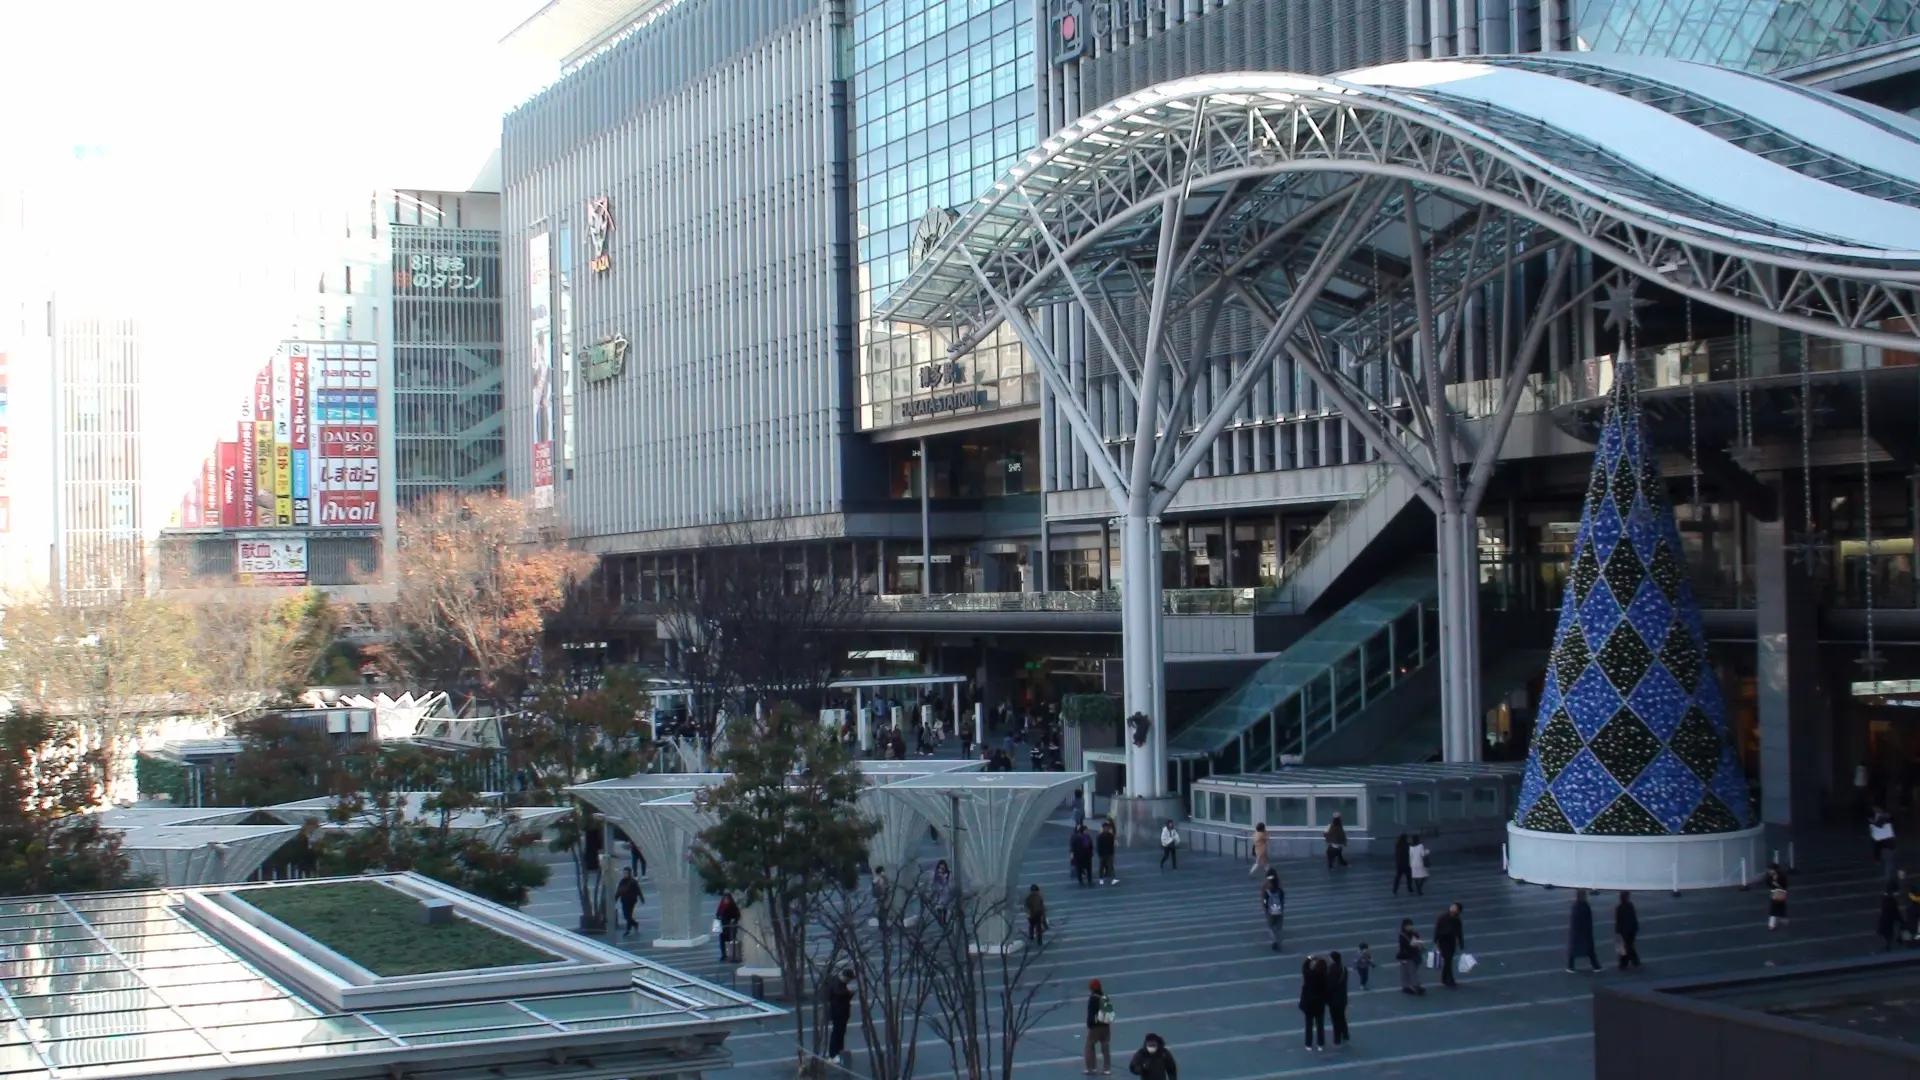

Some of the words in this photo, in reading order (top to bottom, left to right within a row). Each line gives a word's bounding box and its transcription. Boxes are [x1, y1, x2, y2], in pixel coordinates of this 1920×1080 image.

[902, 398, 935, 417] HAKATA
[935, 389, 979, 413] STATION
[324, 431, 374, 442] DAISO
[321, 466, 377, 482] しまむら
[321, 501, 376, 520] Avail
